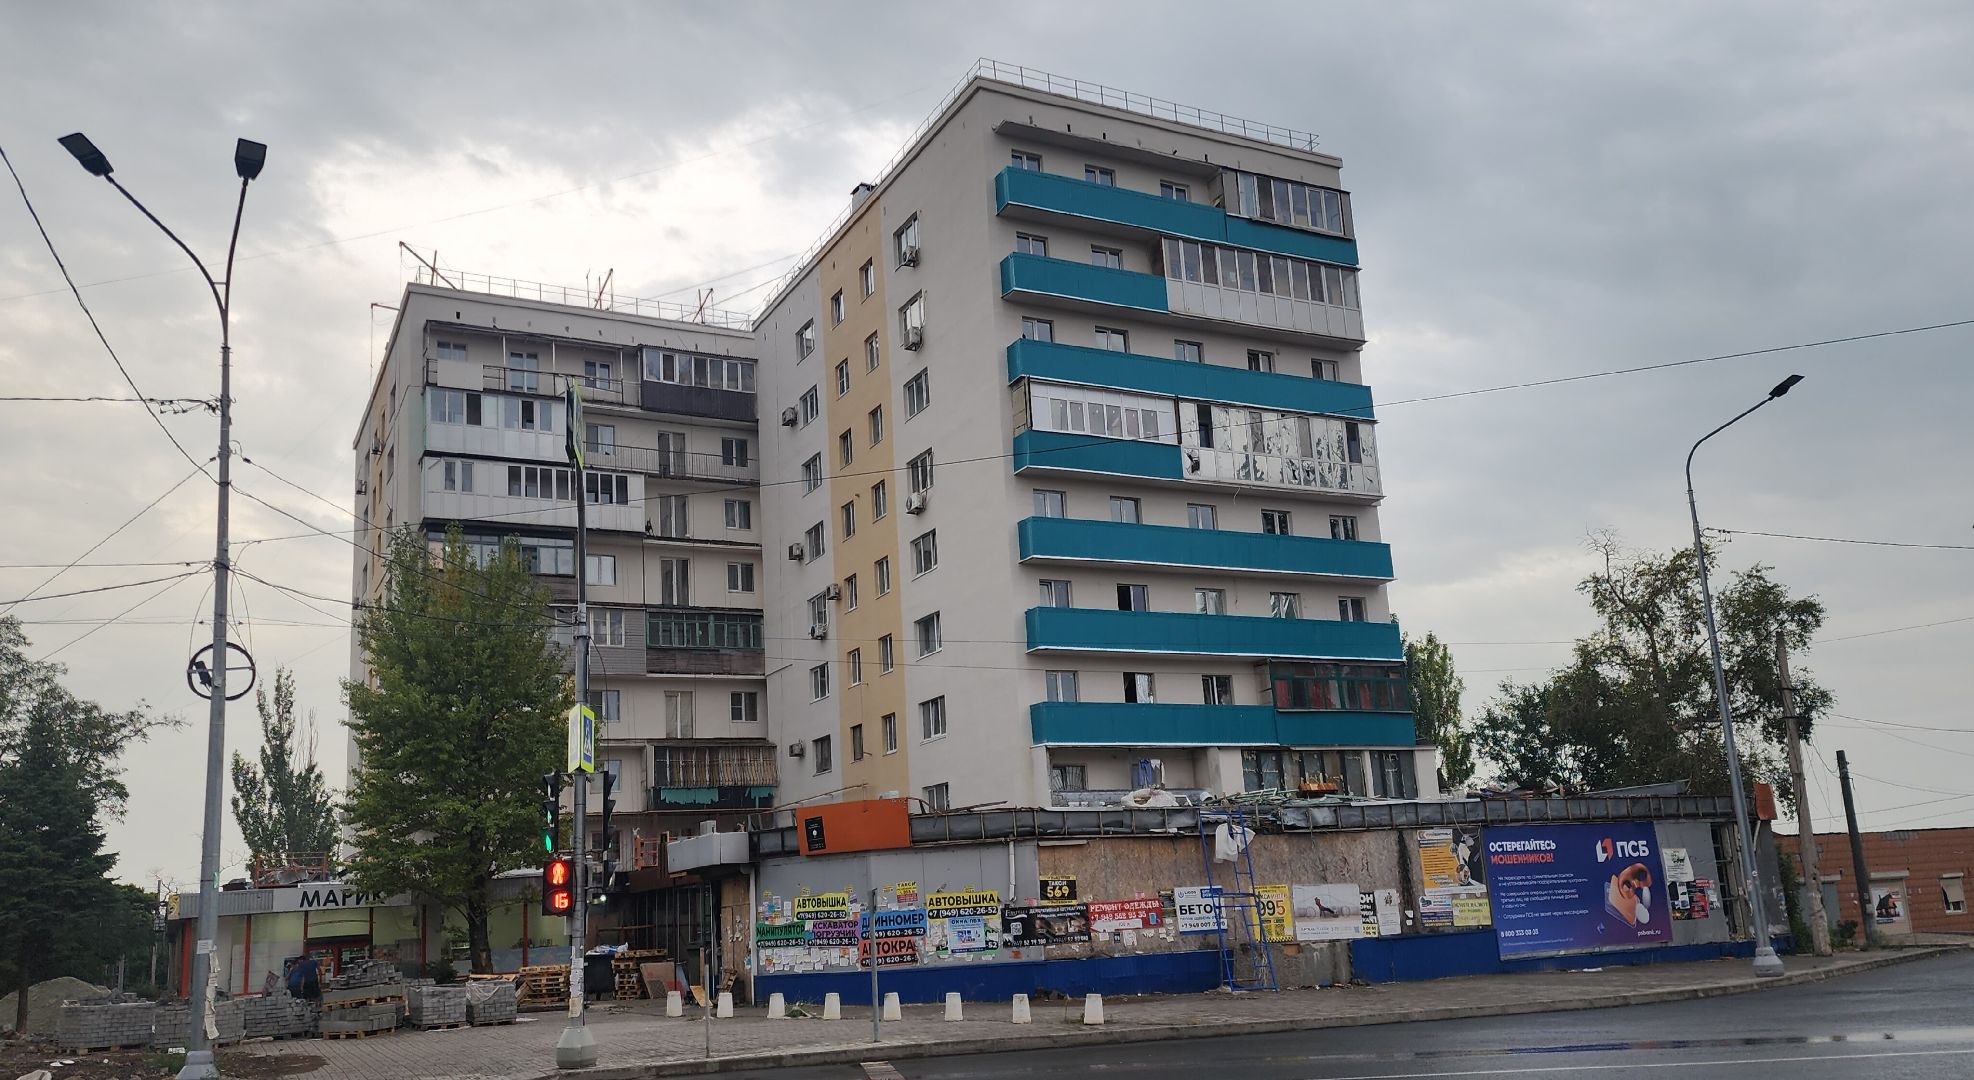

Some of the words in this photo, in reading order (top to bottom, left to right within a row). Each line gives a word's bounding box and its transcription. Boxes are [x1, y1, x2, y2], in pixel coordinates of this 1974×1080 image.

[1489, 839, 1556, 852] ОСТЕРЕГАЙТЕСЬ
[1616, 841, 1650, 858] ПСБ
[1491, 853, 1554, 864] МОШЕННИКОВ!
[1047, 886, 1070, 898] 569
[555, 893, 569, 909] 16
[796, 897, 847, 909] АВТОВЫШКА
[928, 894, 996, 907] АВТОВЫШКА
[1090, 903, 1121, 912] РЕМОНТ
[1124, 901, 1160, 911] ОДЕЖДЫ
[939, 909, 959, 918] (949)
[960, 906, 998, 916] 620-26-52
[1179, 903, 1217, 915] БЕТО
[1258, 900, 1286, 916] 995
[813, 921, 859, 930] КСКАВАТОР
[862, 931, 886, 939] +7(49)
[887, 928, 924, 937] 620-26-52
[777, 938, 805, 946] 620-26-52
[829, 937, 858, 945] 620-26-52
[862, 940, 918, 956] АТОКРА
[862, 957, 885, 966] +7(9)
[886, 955, 918, 963] 620-26-5
